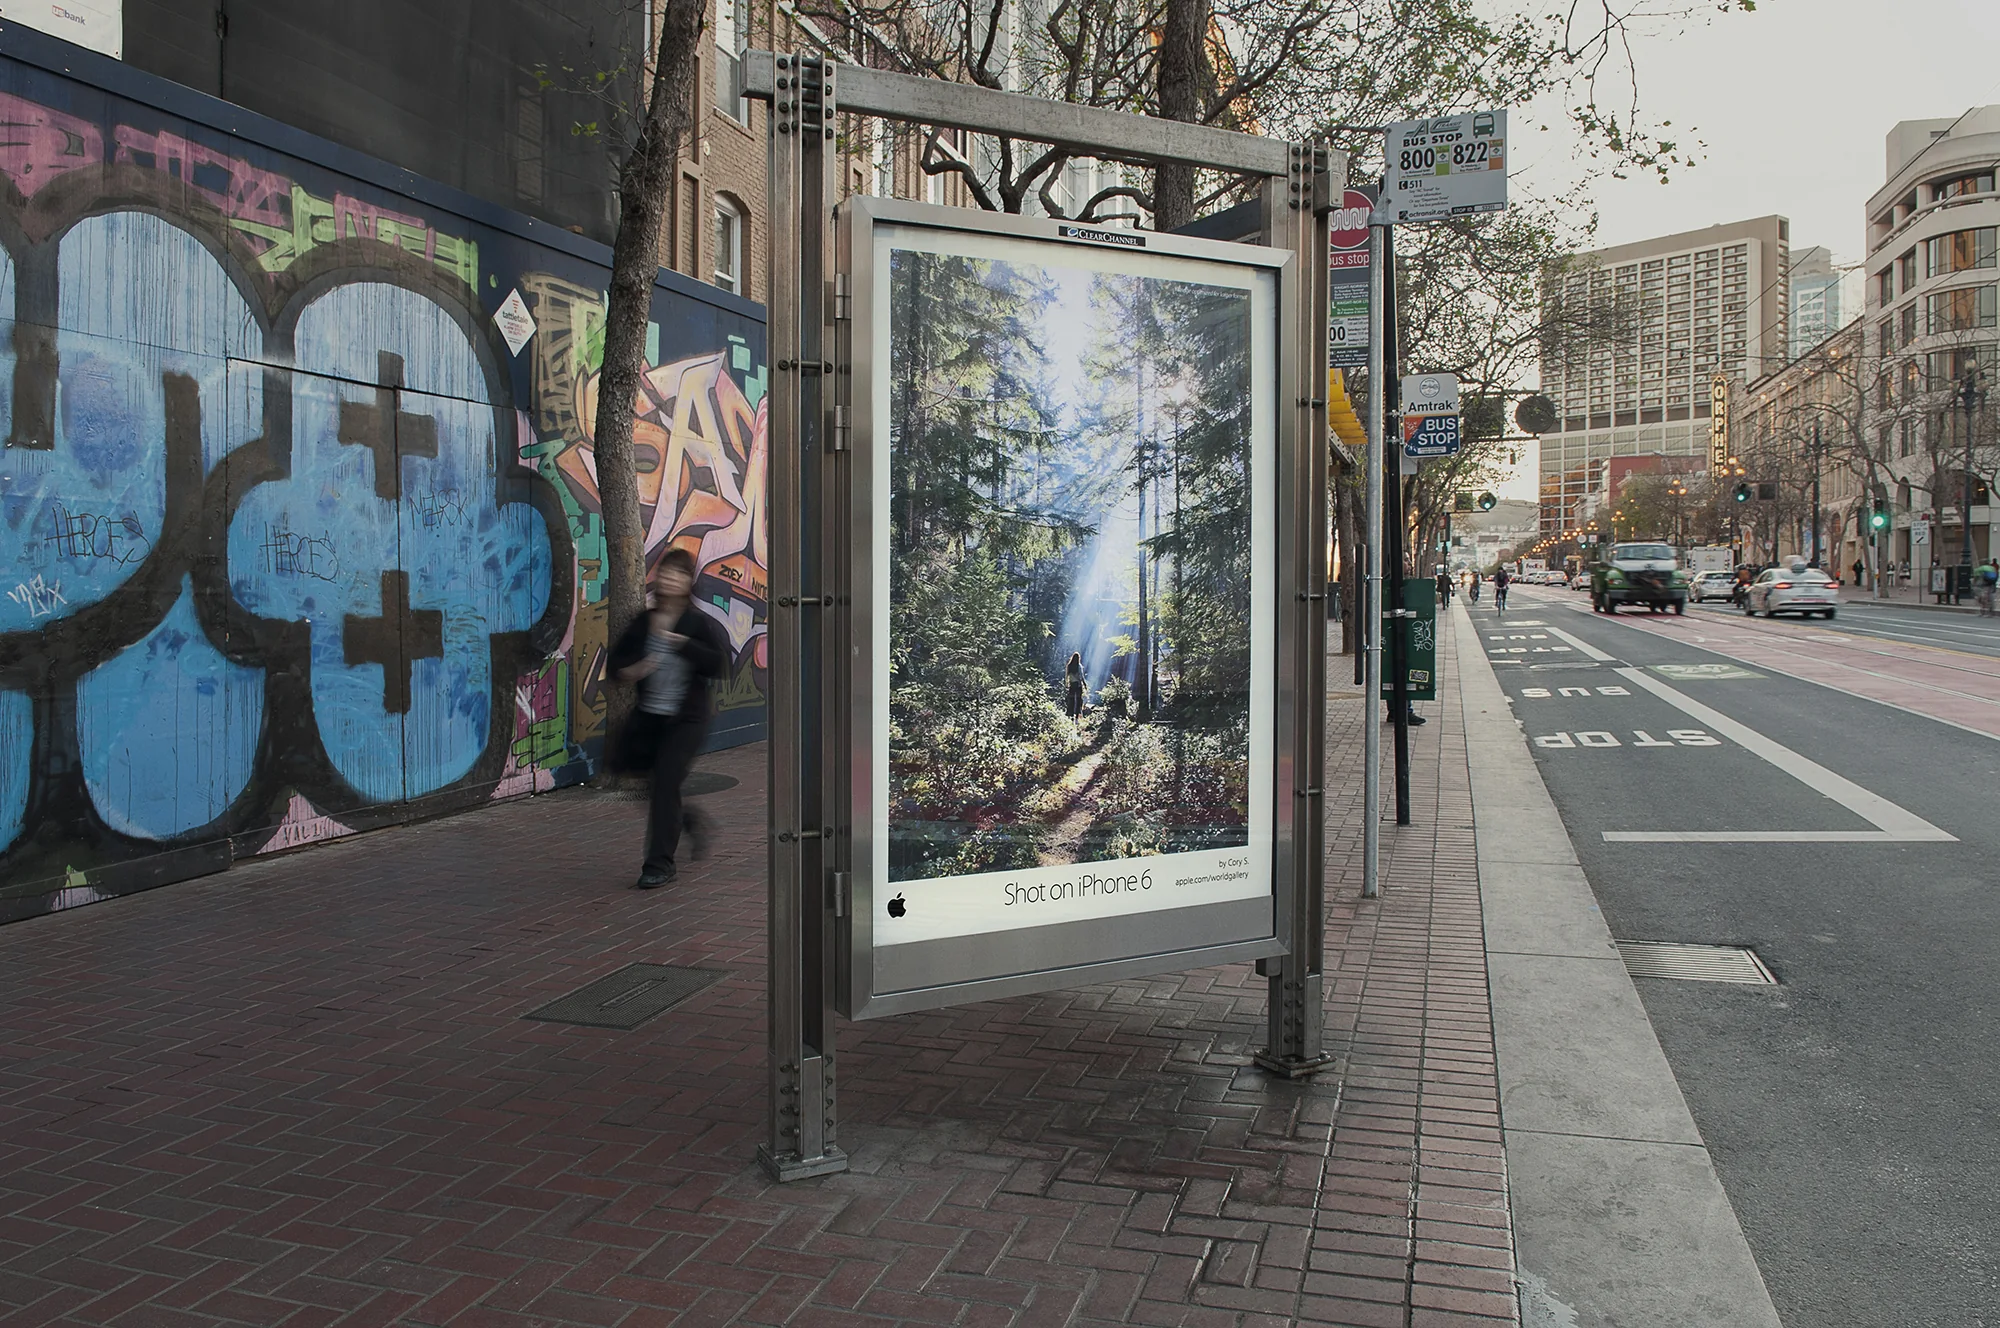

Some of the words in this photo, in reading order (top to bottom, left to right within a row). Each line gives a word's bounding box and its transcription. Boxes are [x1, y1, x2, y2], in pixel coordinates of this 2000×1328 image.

[1403, 136, 1426, 147] BUS
[1432, 133, 1463, 144] STOP
[1400, 147, 1435, 171] 800
[1453, 141, 1488, 165] 822
[1409, 180, 1422, 189] 511
[1347, 253, 1369, 266] stop
[1329, 326, 1346, 342] 00
[1408, 400, 1453, 412] Amtrak
[1426, 418, 1456, 431] BUS
[1418, 432, 1456, 445] STOP
[1521, 686, 1631, 698] BUS
[1532, 729, 1722, 748] STOP
[1218, 860, 1227, 869] by
[1227, 858, 1243, 867] Cory
[1175, 871, 1249, 887] apple.com/worldgallery
[1004, 882, 1046, 906] Shot
[1050, 882, 1074, 901] on
[1078, 873, 1138, 898] iPhone
[1141, 868, 1152, 890] 6
